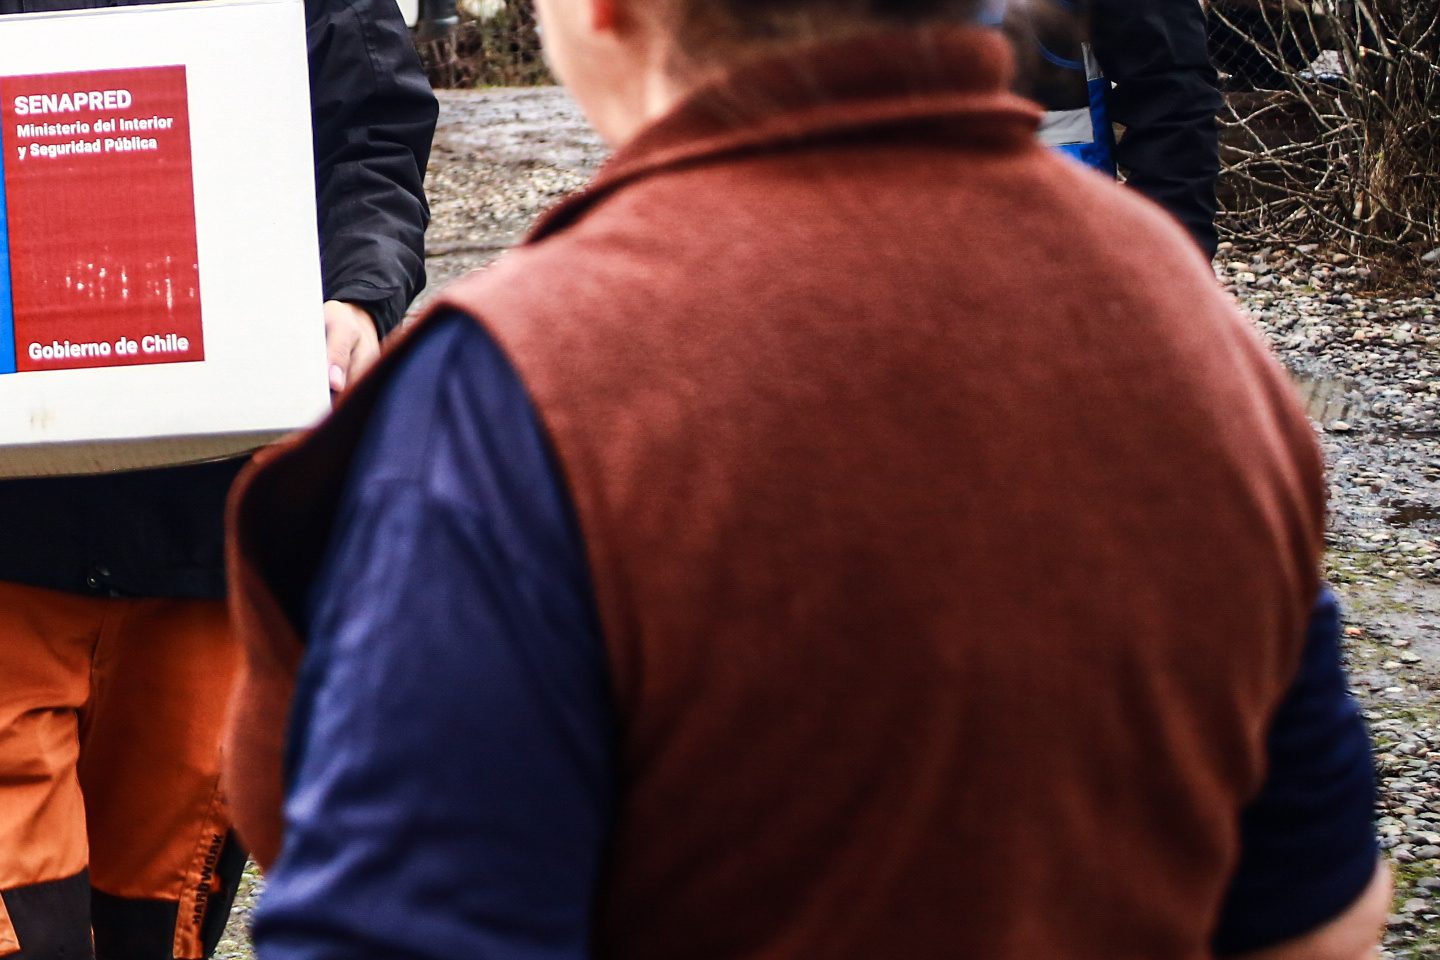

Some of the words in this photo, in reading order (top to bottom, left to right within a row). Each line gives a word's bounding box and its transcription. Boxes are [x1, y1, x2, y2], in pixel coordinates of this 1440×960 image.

[14, 90, 132, 115] SENAPRED
[17, 121, 90, 138] Ministerio
[93, 118, 116, 133] del
[120, 116, 174, 131] Interior
[17, 145, 27, 160] y
[30, 138, 101, 158] Seguridad
[104, 137, 158, 152] Pública
[28, 340, 111, 360] Gobierno
[115, 336, 138, 355] de
[141, 333, 189, 353] Chile
[193, 834, 223, 924] HARDWORK
